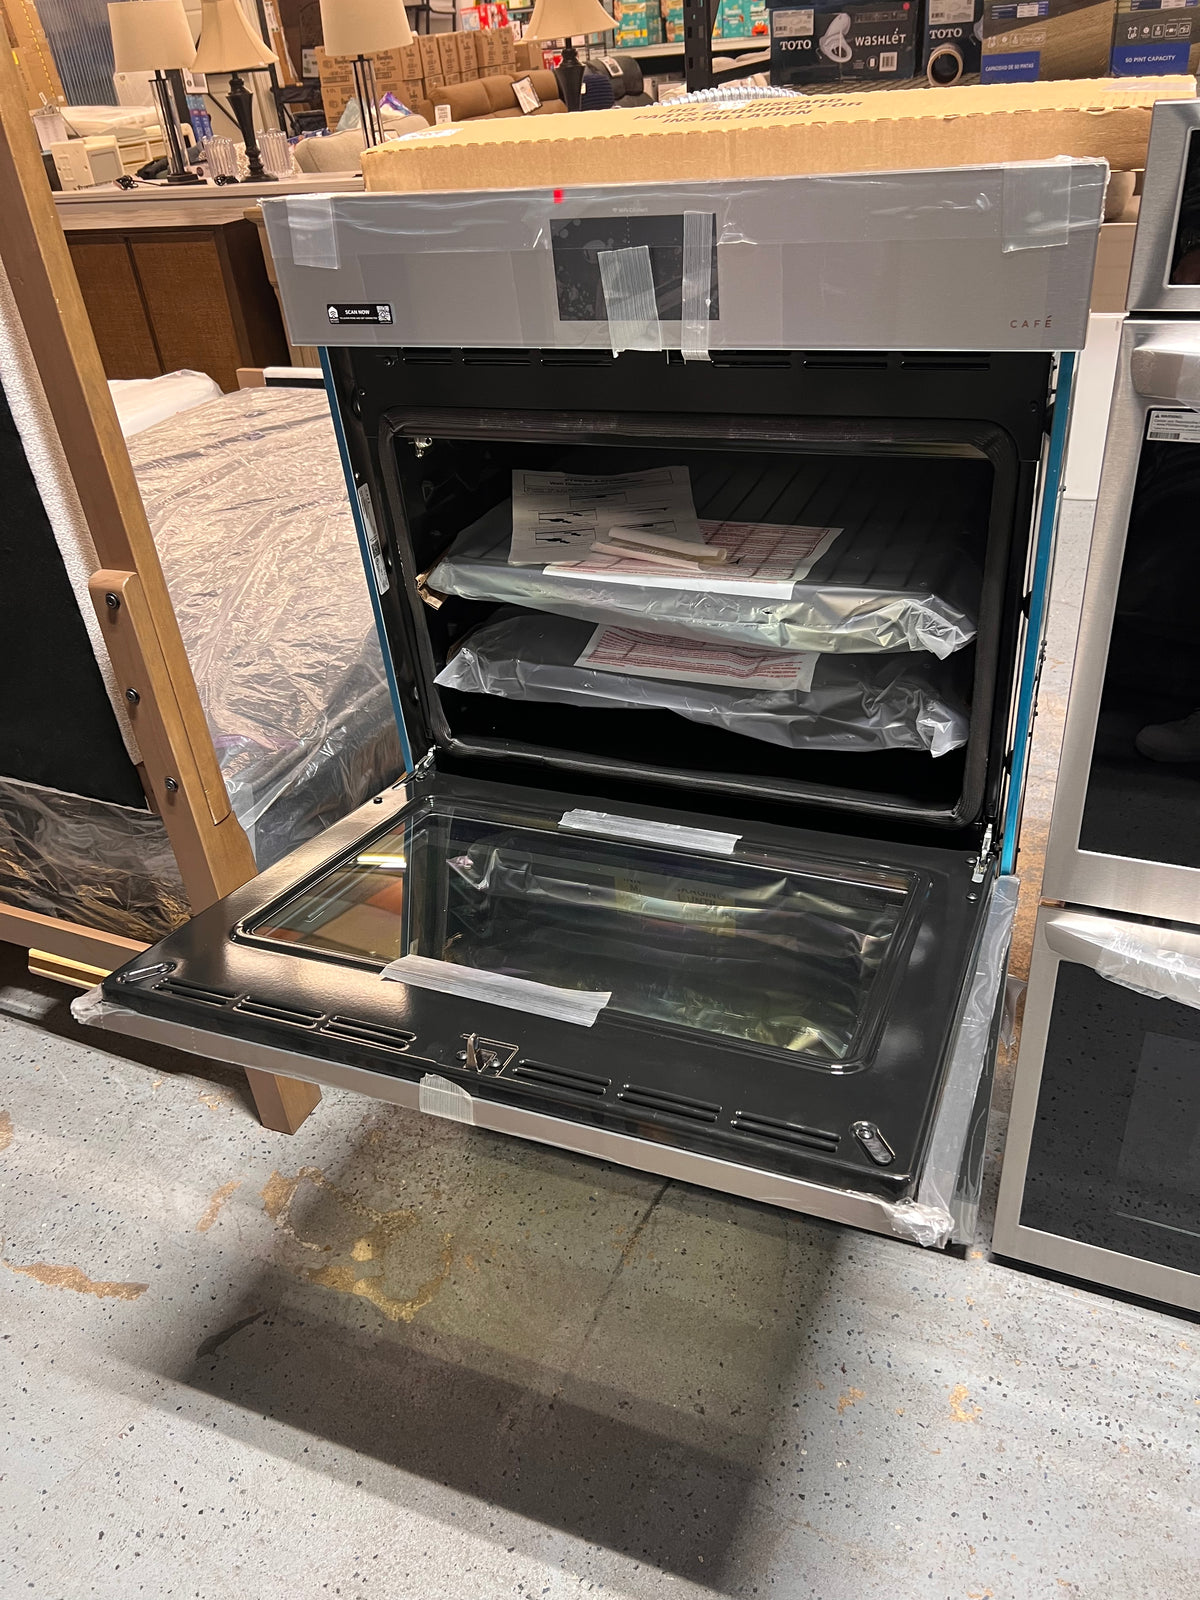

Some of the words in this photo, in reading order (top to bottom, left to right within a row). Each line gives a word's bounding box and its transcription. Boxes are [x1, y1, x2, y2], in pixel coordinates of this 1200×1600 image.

[929, 27, 962, 39] TOTO
[780, 39, 812, 51] TOTO
[1147, 54, 1176, 62] CAPACITY
[749, 98, 843, 108] DISCARD
[633, 111, 699, 120] PARTS
[703, 104, 812, 116] REQUIRED
[661, 109, 812, 123] INSTALLATION
[1010, 314, 1053, 329] CAFÉ
